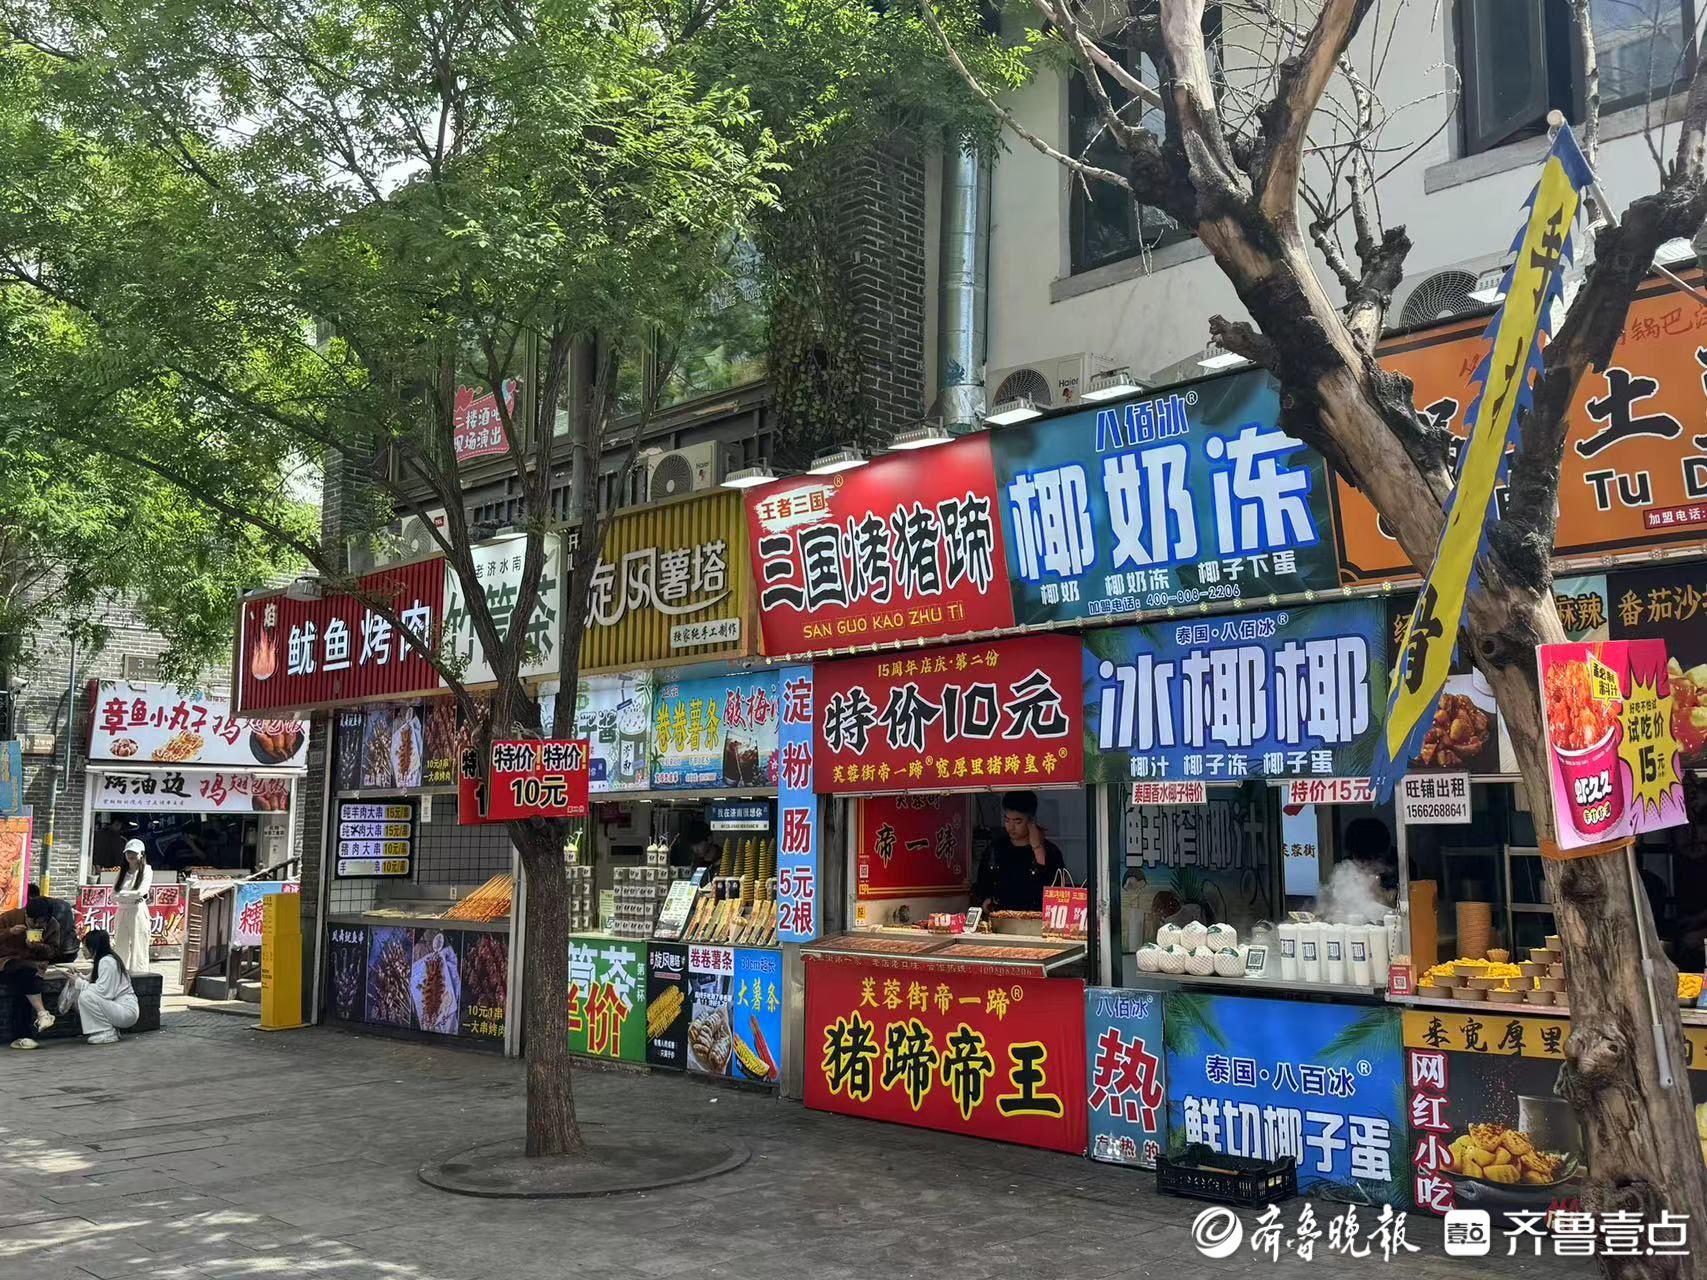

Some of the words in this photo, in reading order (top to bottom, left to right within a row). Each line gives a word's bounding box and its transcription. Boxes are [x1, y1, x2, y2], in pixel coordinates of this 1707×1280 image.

[760, 491, 826, 523] 王者三国
[1008, 424, 1320, 582] 椰奶冻
[758, 492, 994, 612] 三国烤猪蹄
[1198, 551, 1297, 584] 椰子下蛋
[1040, 581, 1080, 605] 椰奶
[1104, 568, 1170, 596] 椰奶冻
[1145, 584, 1241, 606] 400-808-2206
[803, 623, 832, 639] SAN
[837, 617, 867, 634] GUO
[872, 612, 904, 630] KAO
[909, 605, 942, 626] ZHU
[947, 601, 965, 619] TI
[1616, 583, 1707, 627] 番茄沙
[287, 599, 432, 677] 鱿鱼烤肉
[672, 621, 738, 644] 独家纯手工制作
[1098, 636, 1369, 749] 冰椰椰
[100, 697, 208, 736] 章鱼小丸子
[655, 696, 720, 753] 卷卷薯条
[823, 669, 1070, 755] 特价10元
[1628, 711, 1665, 743] 试吃价
[782, 675, 814, 857] 淀粉肠
[1130, 757, 1169, 778] 椰汁
[1183, 755, 1248, 776] 椰子冻
[1263, 751, 1334, 775] 椰子蛋
[510, 775, 568, 808] 10元
[1291, 779, 1372, 804] 特价15元
[1406, 780, 1466, 798] 旺铺出租
[343, 806, 383, 819] 纯羊肉大串
[1406, 804, 1468, 818] 15662688641
[342, 825, 382, 837] 纯肉大串
[780, 868, 813, 899] 5元
[779, 899, 814, 935] 2根
[691, 948, 733, 971] 卷卷薯条
[636, 962, 646, 1003] 第二杯
[737, 977, 780, 1012] 大薯条
[821, 1010, 1064, 1121] 猪蹄帝王
[1088, 1026, 1164, 1133] 热
[1183, 1095, 1392, 1183] 鲜切椰子蛋
[1408, 1051, 1454, 1214] 网红小吃
